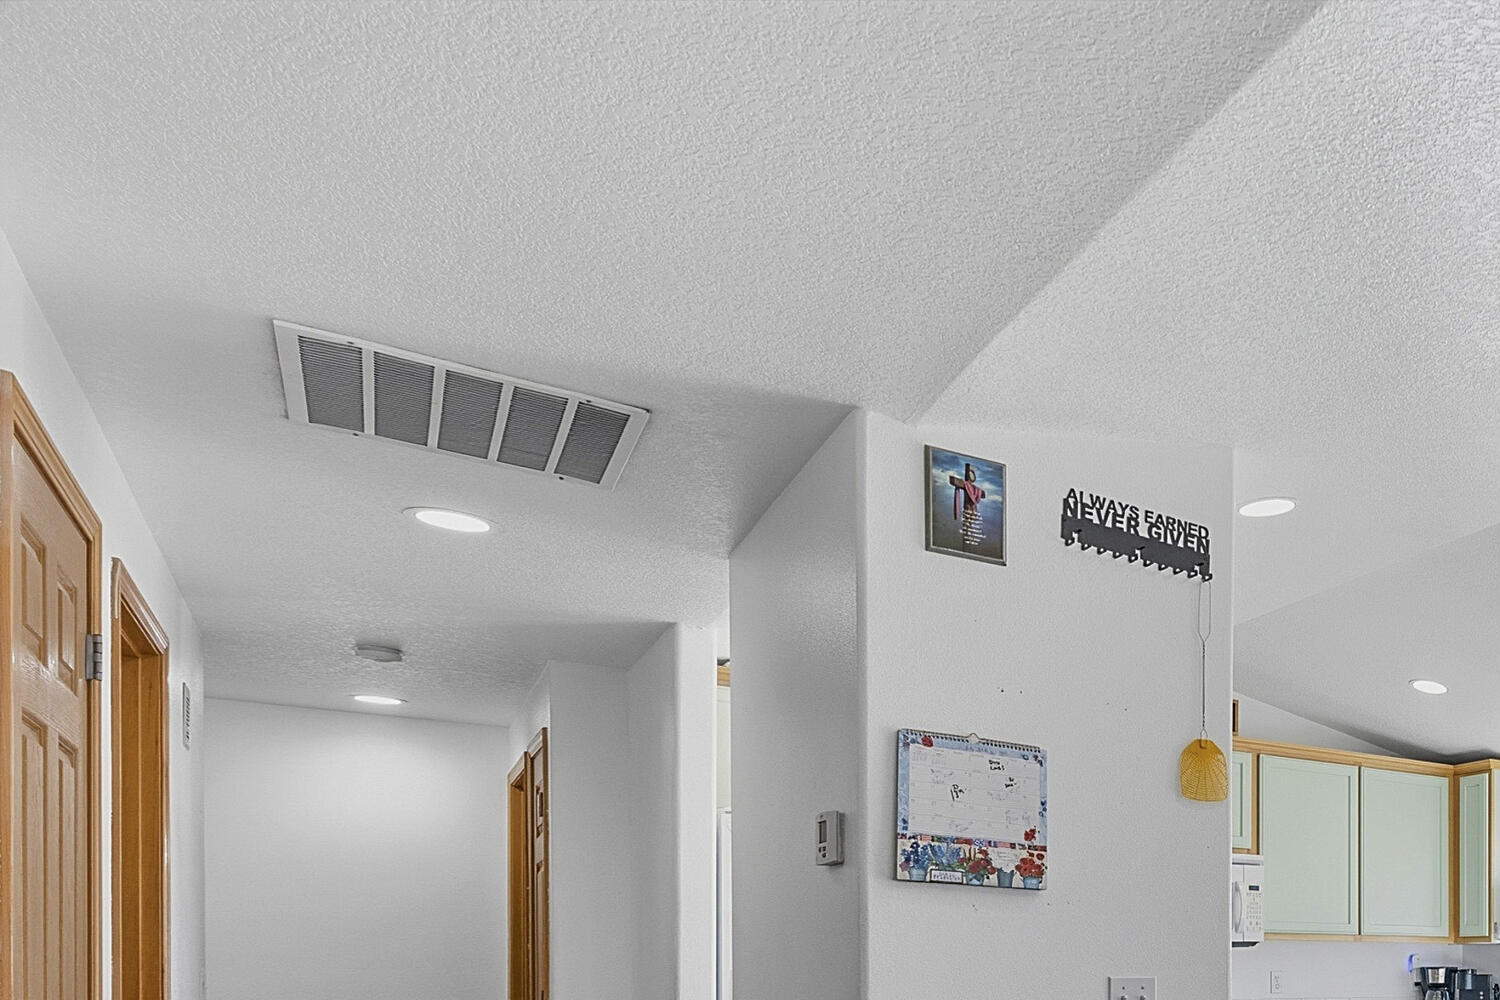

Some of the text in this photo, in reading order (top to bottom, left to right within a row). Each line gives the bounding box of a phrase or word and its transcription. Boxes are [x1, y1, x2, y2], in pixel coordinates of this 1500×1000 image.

[1063, 498, 1210, 554] NEVER GIVEN
[1066, 488, 1210, 539] ALWAYS EARNED
